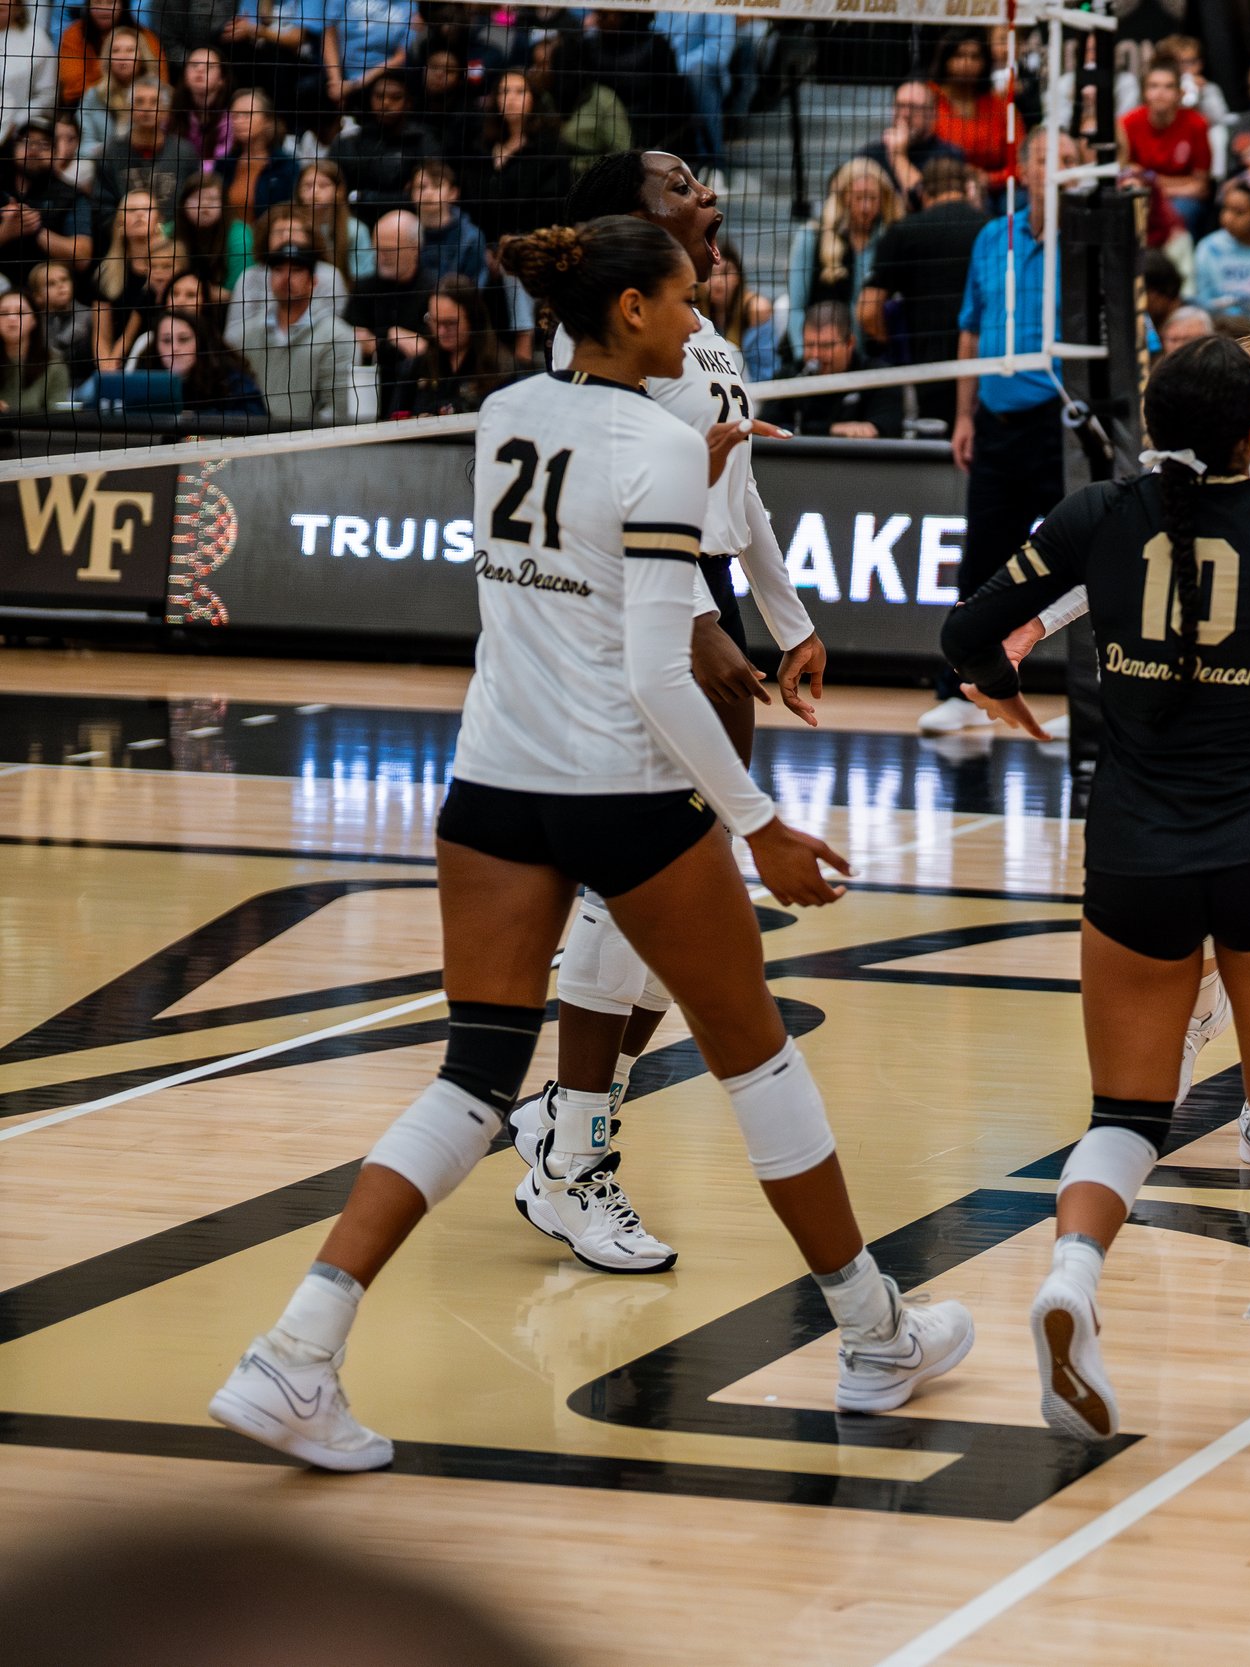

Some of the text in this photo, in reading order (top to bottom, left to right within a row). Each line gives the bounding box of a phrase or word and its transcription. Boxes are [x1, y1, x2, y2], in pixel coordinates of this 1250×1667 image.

[688, 346, 737, 376] WAKE
[17, 471, 153, 582] WF
[290, 513, 475, 563] TRUIS
[490, 436, 574, 551] 21
[727, 512, 968, 605] AKE
[1141, 531, 1240, 646] 10
[1106, 642, 1173, 680] Demon
